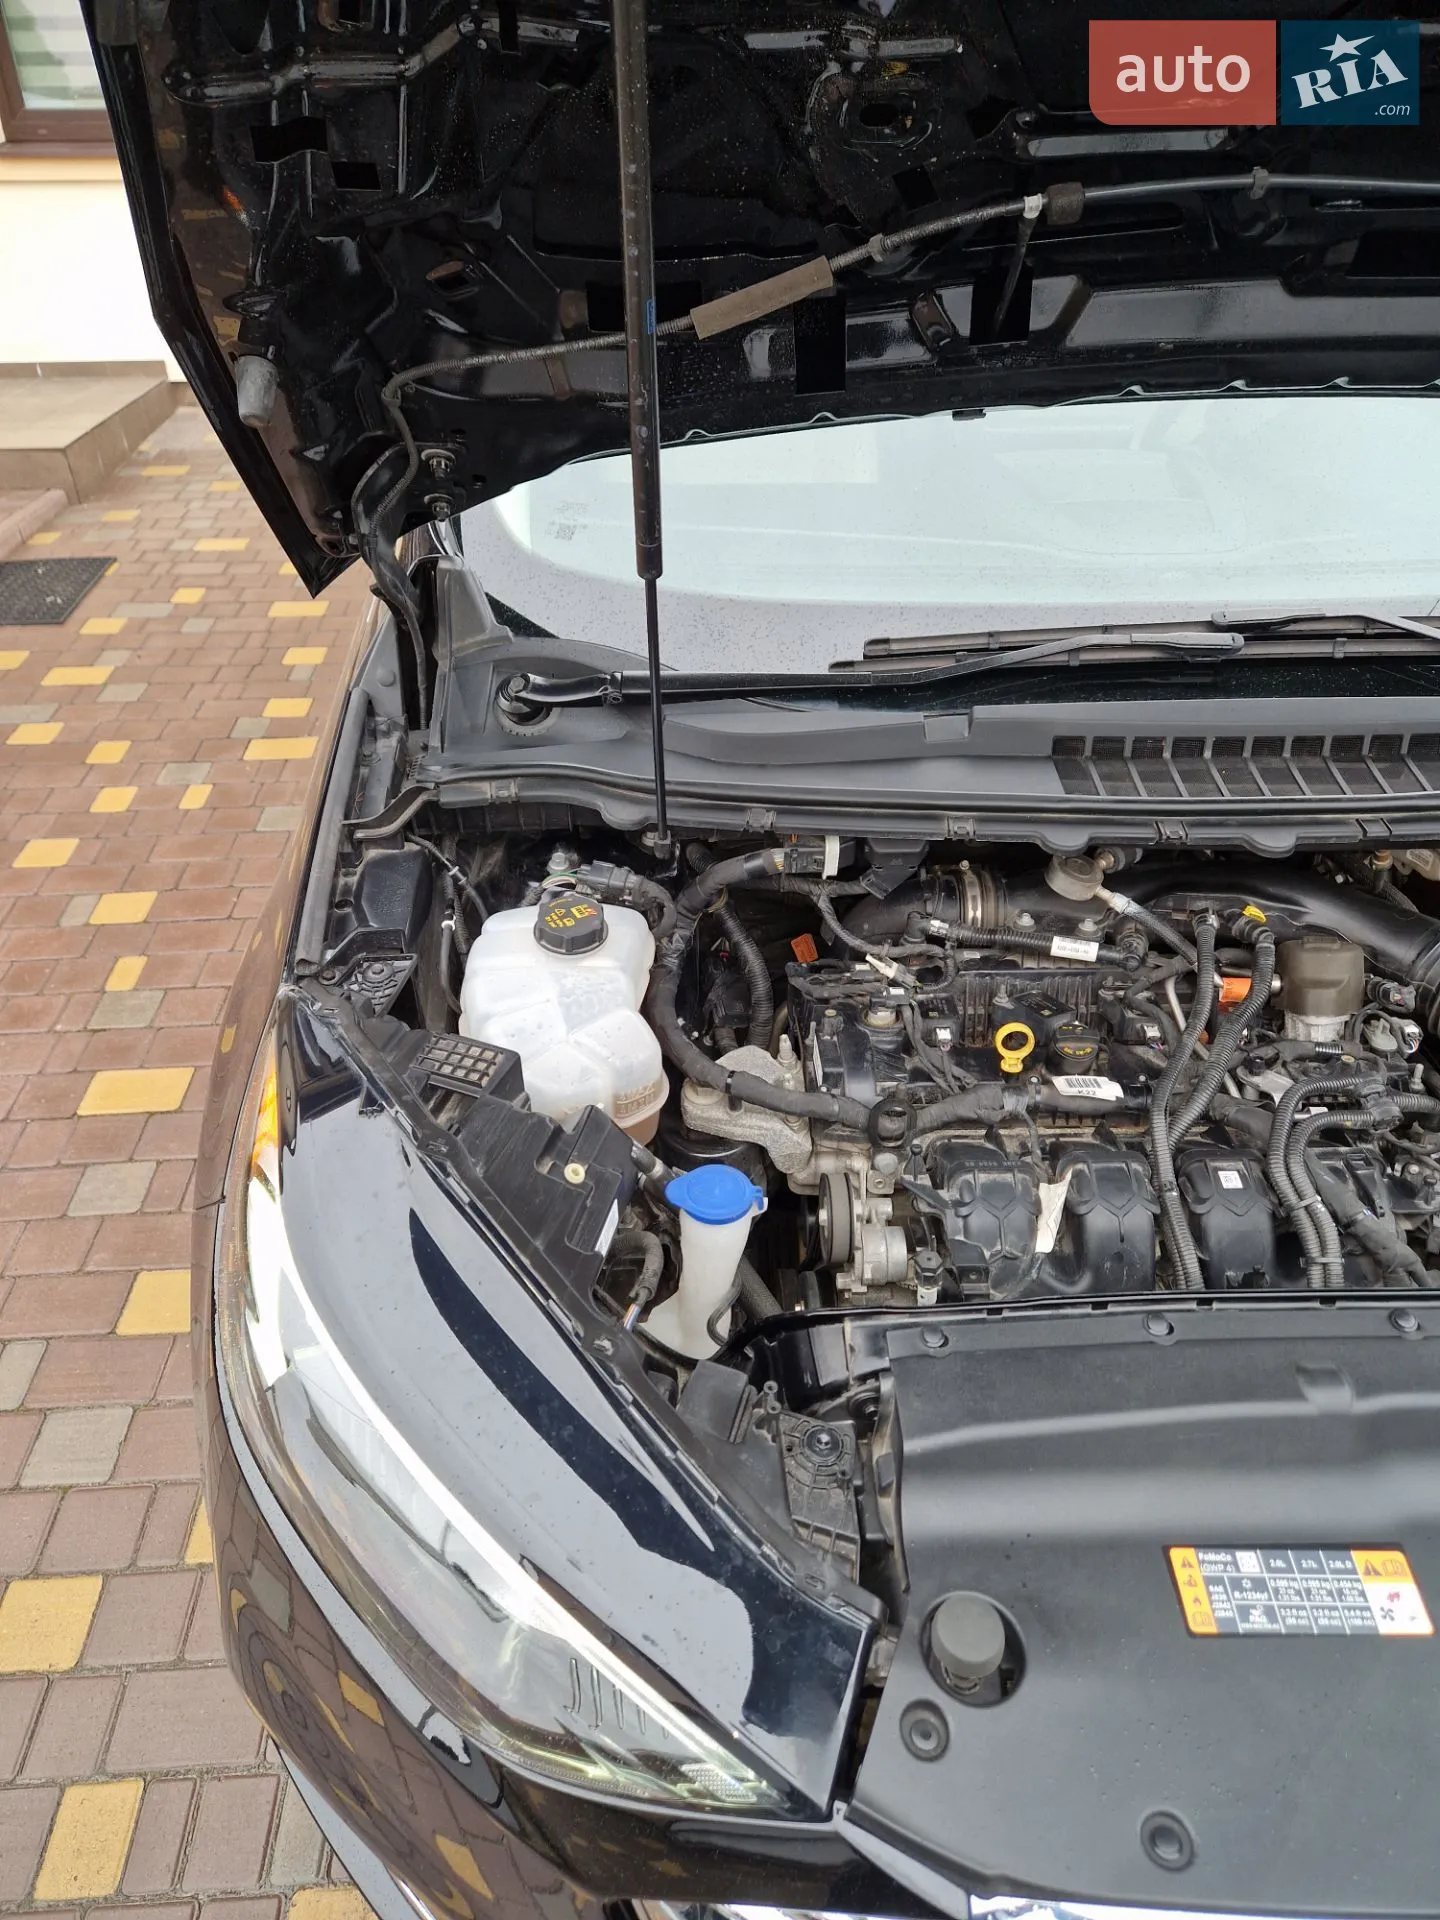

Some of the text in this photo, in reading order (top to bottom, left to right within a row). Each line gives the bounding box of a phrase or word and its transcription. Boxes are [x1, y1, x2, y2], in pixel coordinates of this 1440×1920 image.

[1198, 1551, 1232, 1561] FoMoCo
[1200, 1563, 1236, 1573] (GWP 4)
[1300, 1559, 1318, 1568] 2.7L
[1233, 1590, 1268, 1600] R-1234yf
